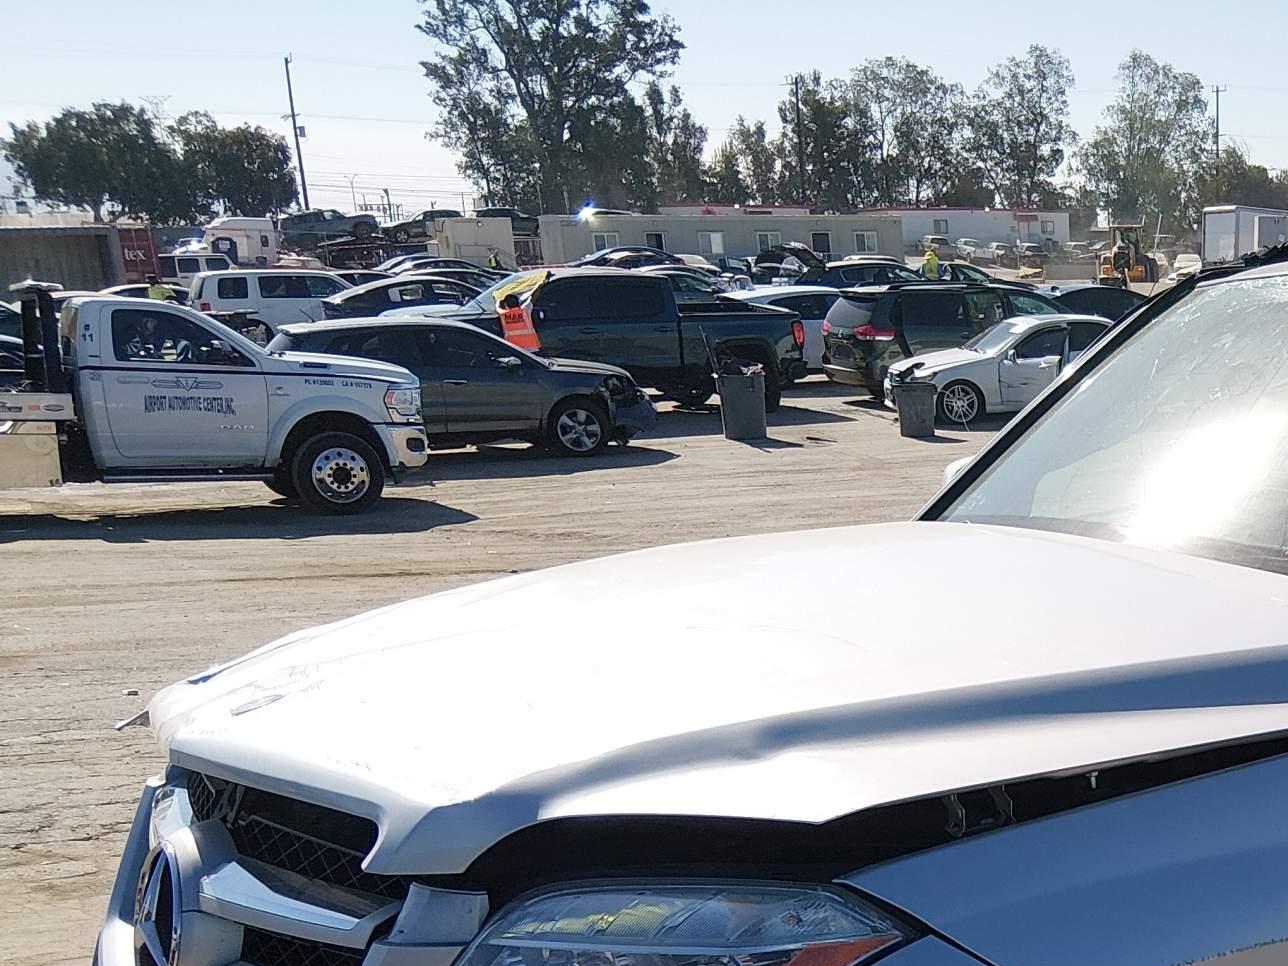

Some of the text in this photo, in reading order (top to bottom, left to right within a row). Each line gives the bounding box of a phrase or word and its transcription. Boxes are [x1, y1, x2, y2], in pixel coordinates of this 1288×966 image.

[81, 333, 94, 342] 11
[144, 395, 167, 413] AIRPORT
[168, 395, 202, 412] AUTOMOTIVE
